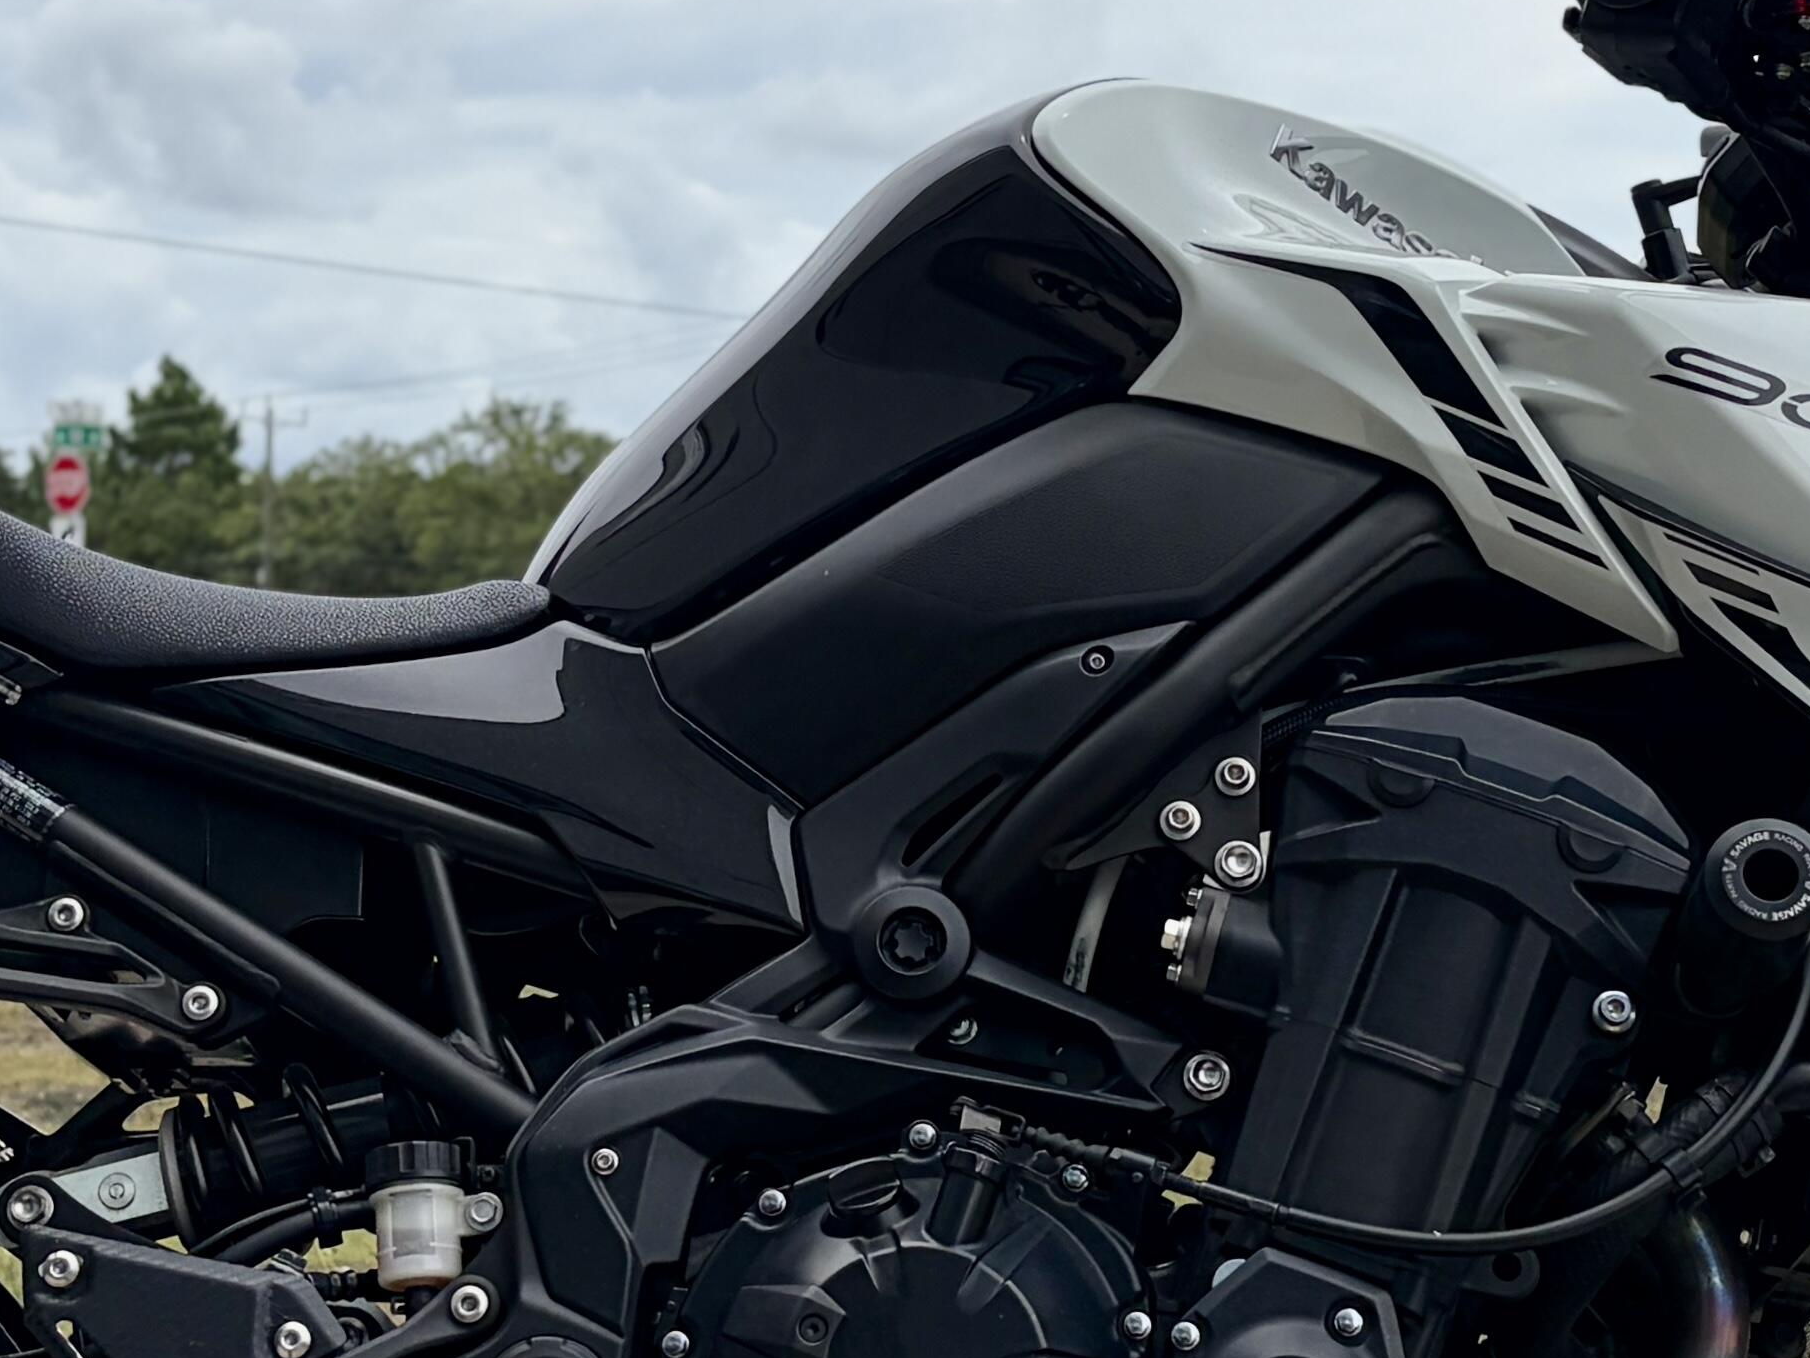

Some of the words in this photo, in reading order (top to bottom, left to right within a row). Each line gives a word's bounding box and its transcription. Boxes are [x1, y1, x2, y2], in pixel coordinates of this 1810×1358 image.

[1269, 123, 1483, 262] Kawas
[1729, 831, 1771, 858] SAVAGE
[1773, 832, 1804, 853] RACING
